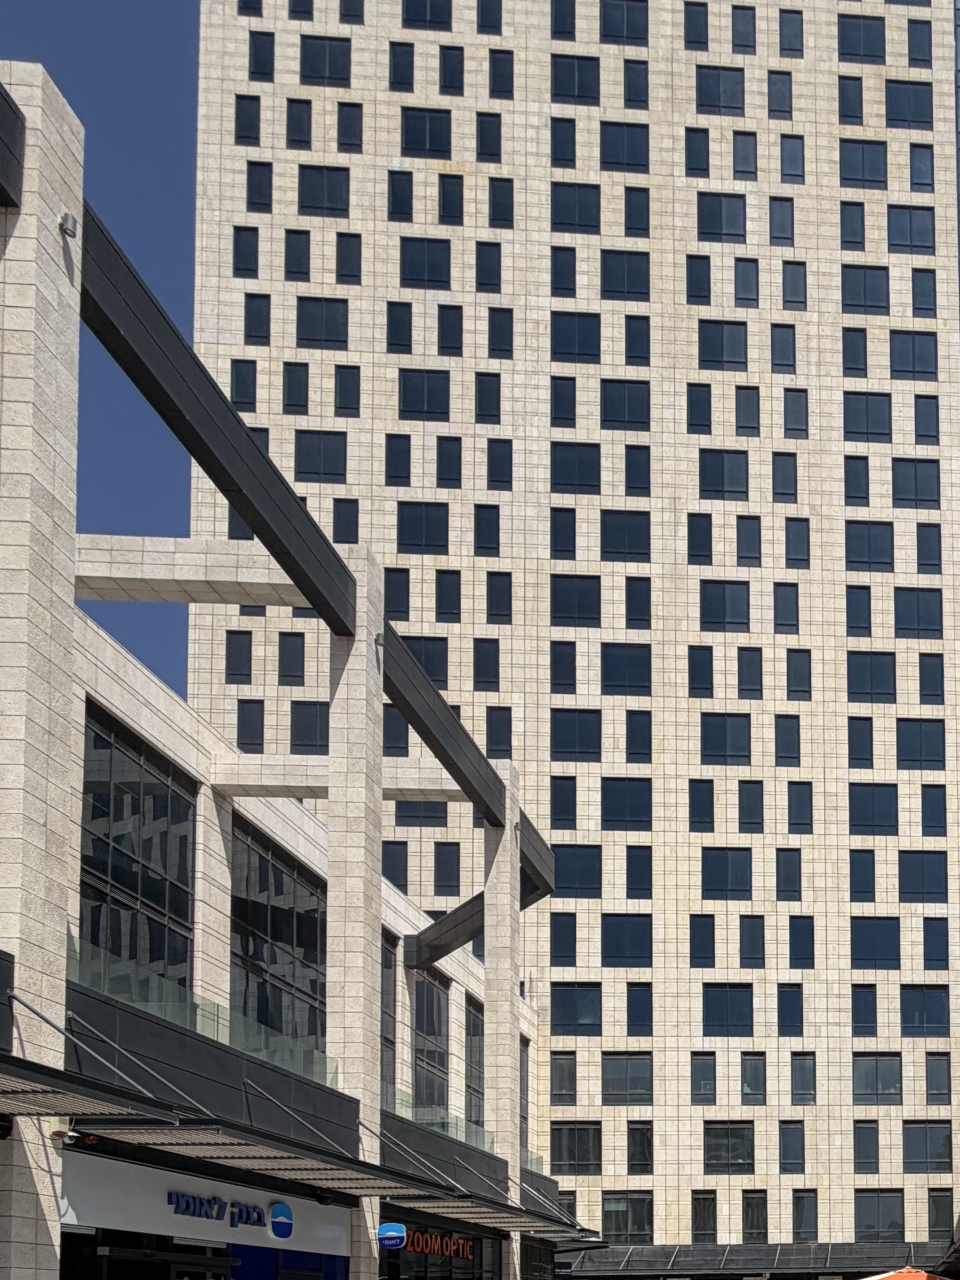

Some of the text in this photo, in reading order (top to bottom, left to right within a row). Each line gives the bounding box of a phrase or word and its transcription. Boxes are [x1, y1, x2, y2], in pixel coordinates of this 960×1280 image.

[167, 1191, 267, 1228] בנק לאומי
[406, 1230, 474, 1260] ZOOM OPTIC
